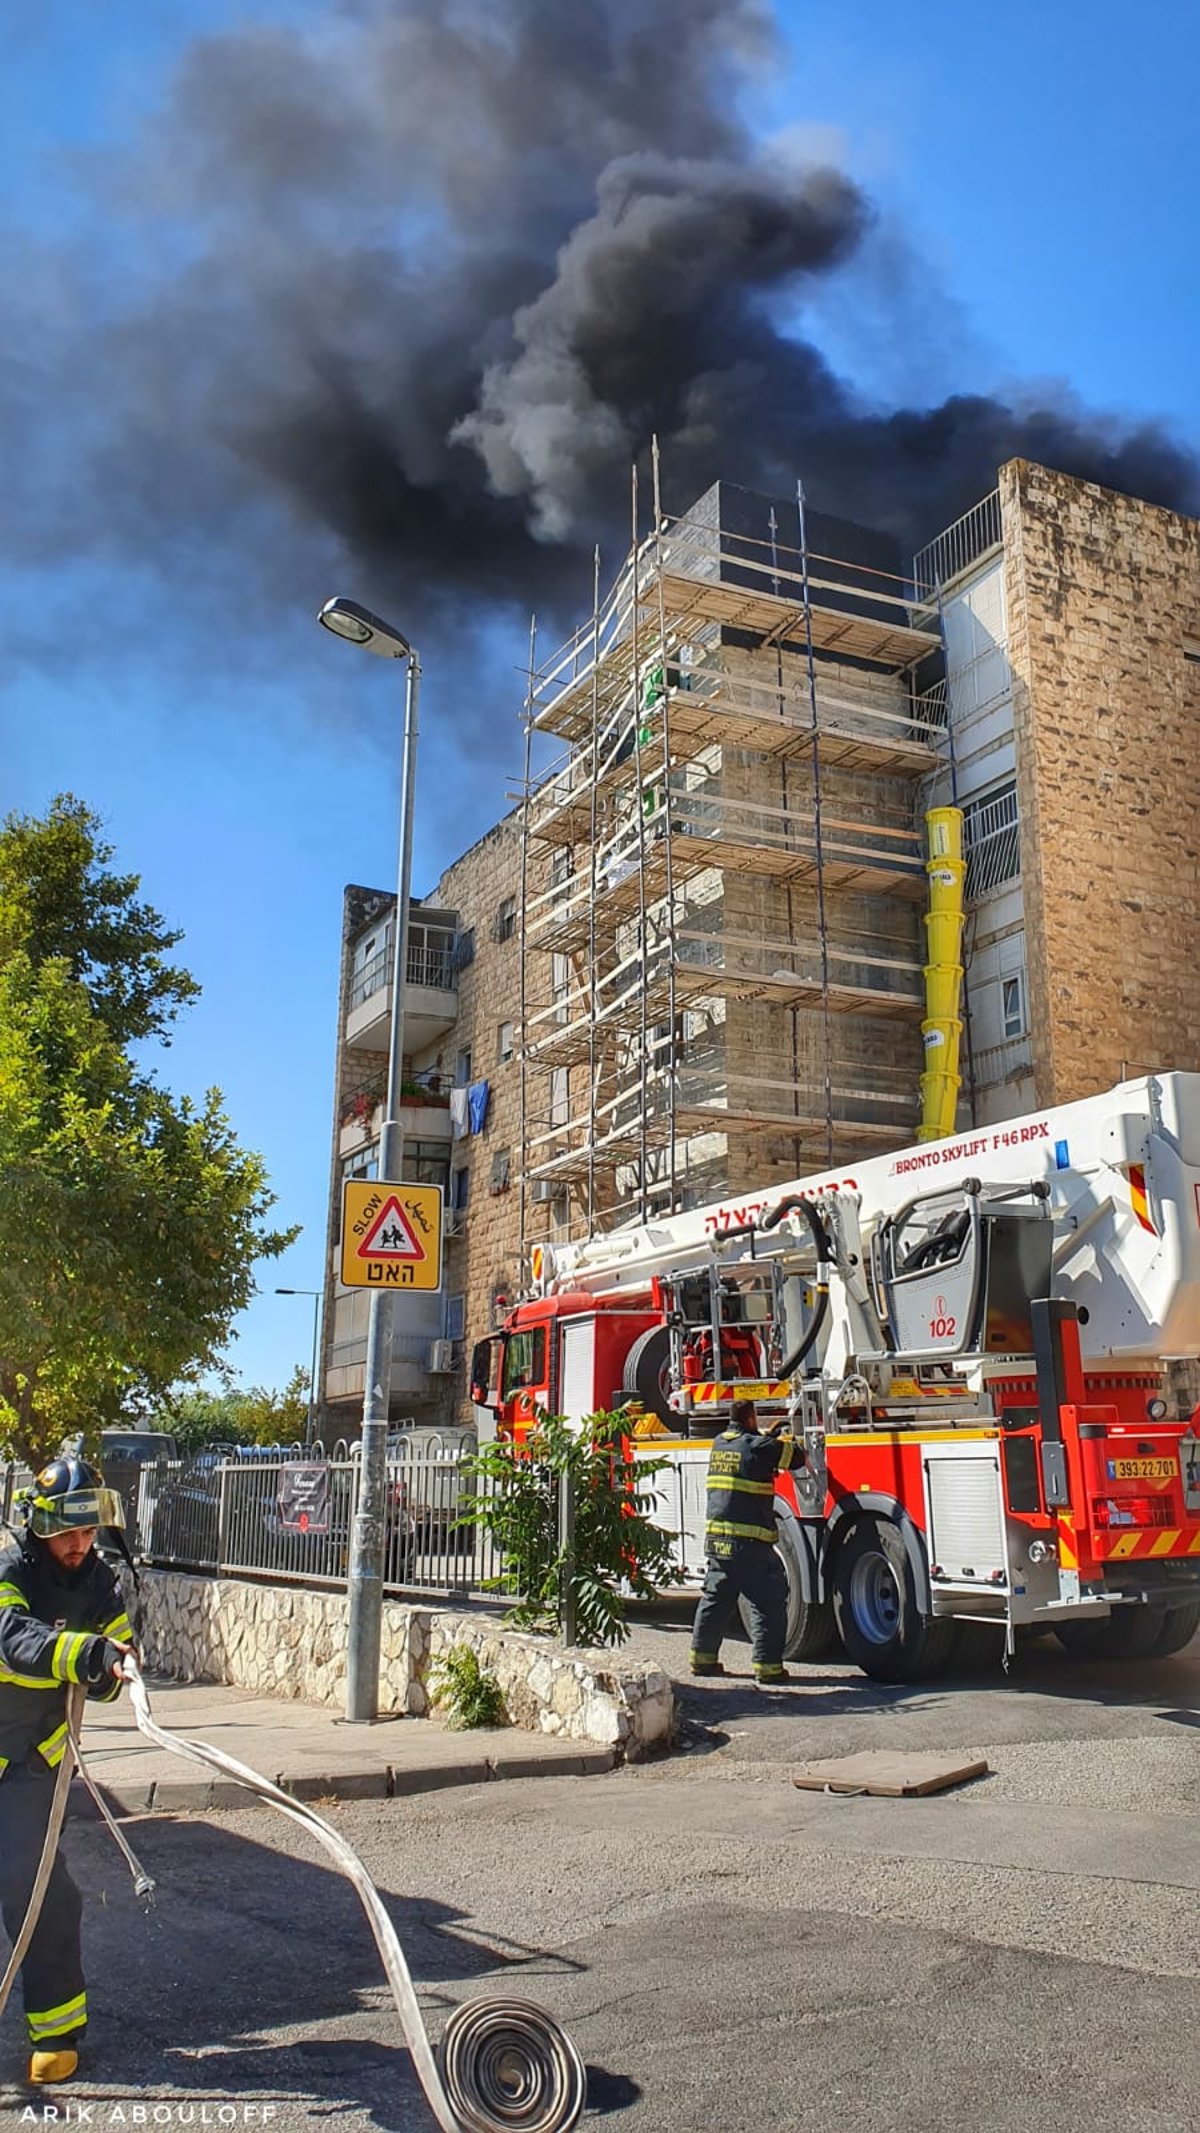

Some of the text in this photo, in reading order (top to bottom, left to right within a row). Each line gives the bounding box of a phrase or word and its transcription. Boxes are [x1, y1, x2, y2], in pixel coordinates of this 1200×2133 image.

[896, 1152, 940, 1174] BRONTO
[942, 1138, 987, 1162] SKYLIFT
[353, 1193, 382, 1236] SLOW
[367, 1262, 414, 1283] האט
[930, 1317, 956, 1338] 102
